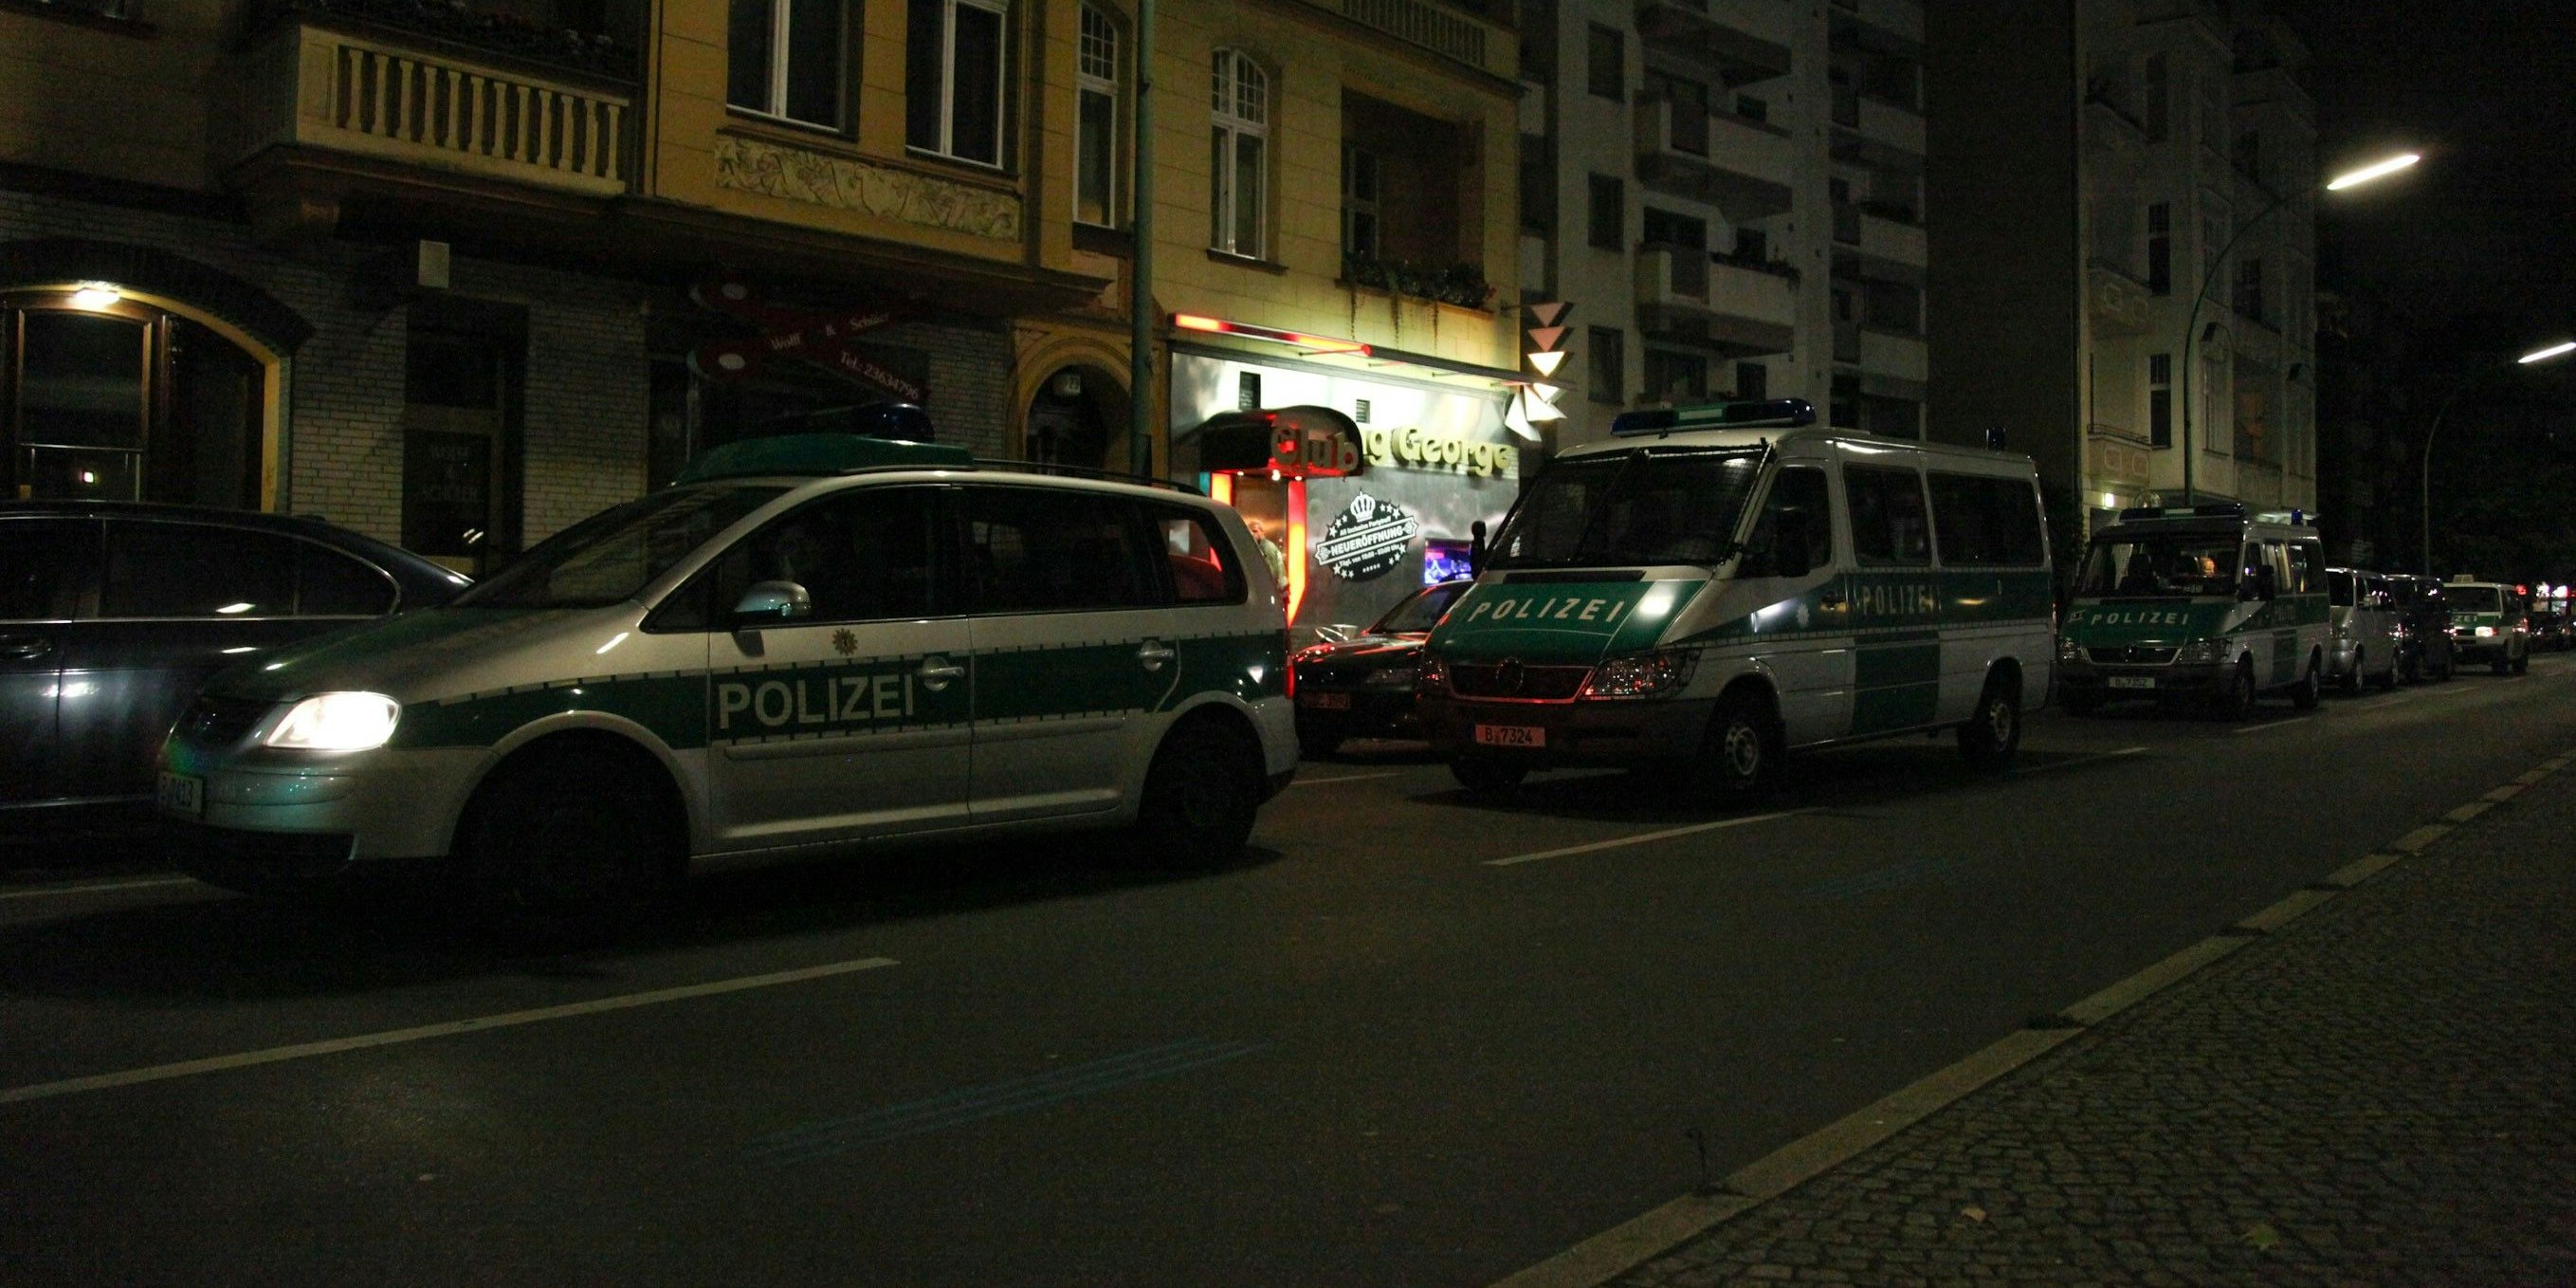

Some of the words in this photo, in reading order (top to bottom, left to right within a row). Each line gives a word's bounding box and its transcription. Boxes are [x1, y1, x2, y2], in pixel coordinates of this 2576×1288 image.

[1271, 426, 1360, 472] Club
[1396, 426, 1512, 477] George
[1330, 524, 1403, 556] NEUERÖFFNUNG
[1468, 598, 1625, 623] POLIZEI
[1863, 584, 1934, 616] POLIZEI
[2091, 612, 2189, 626] POLIZEI
[718, 673, 914, 730] POLIZEI
[1500, 727, 1533, 745] 7324
